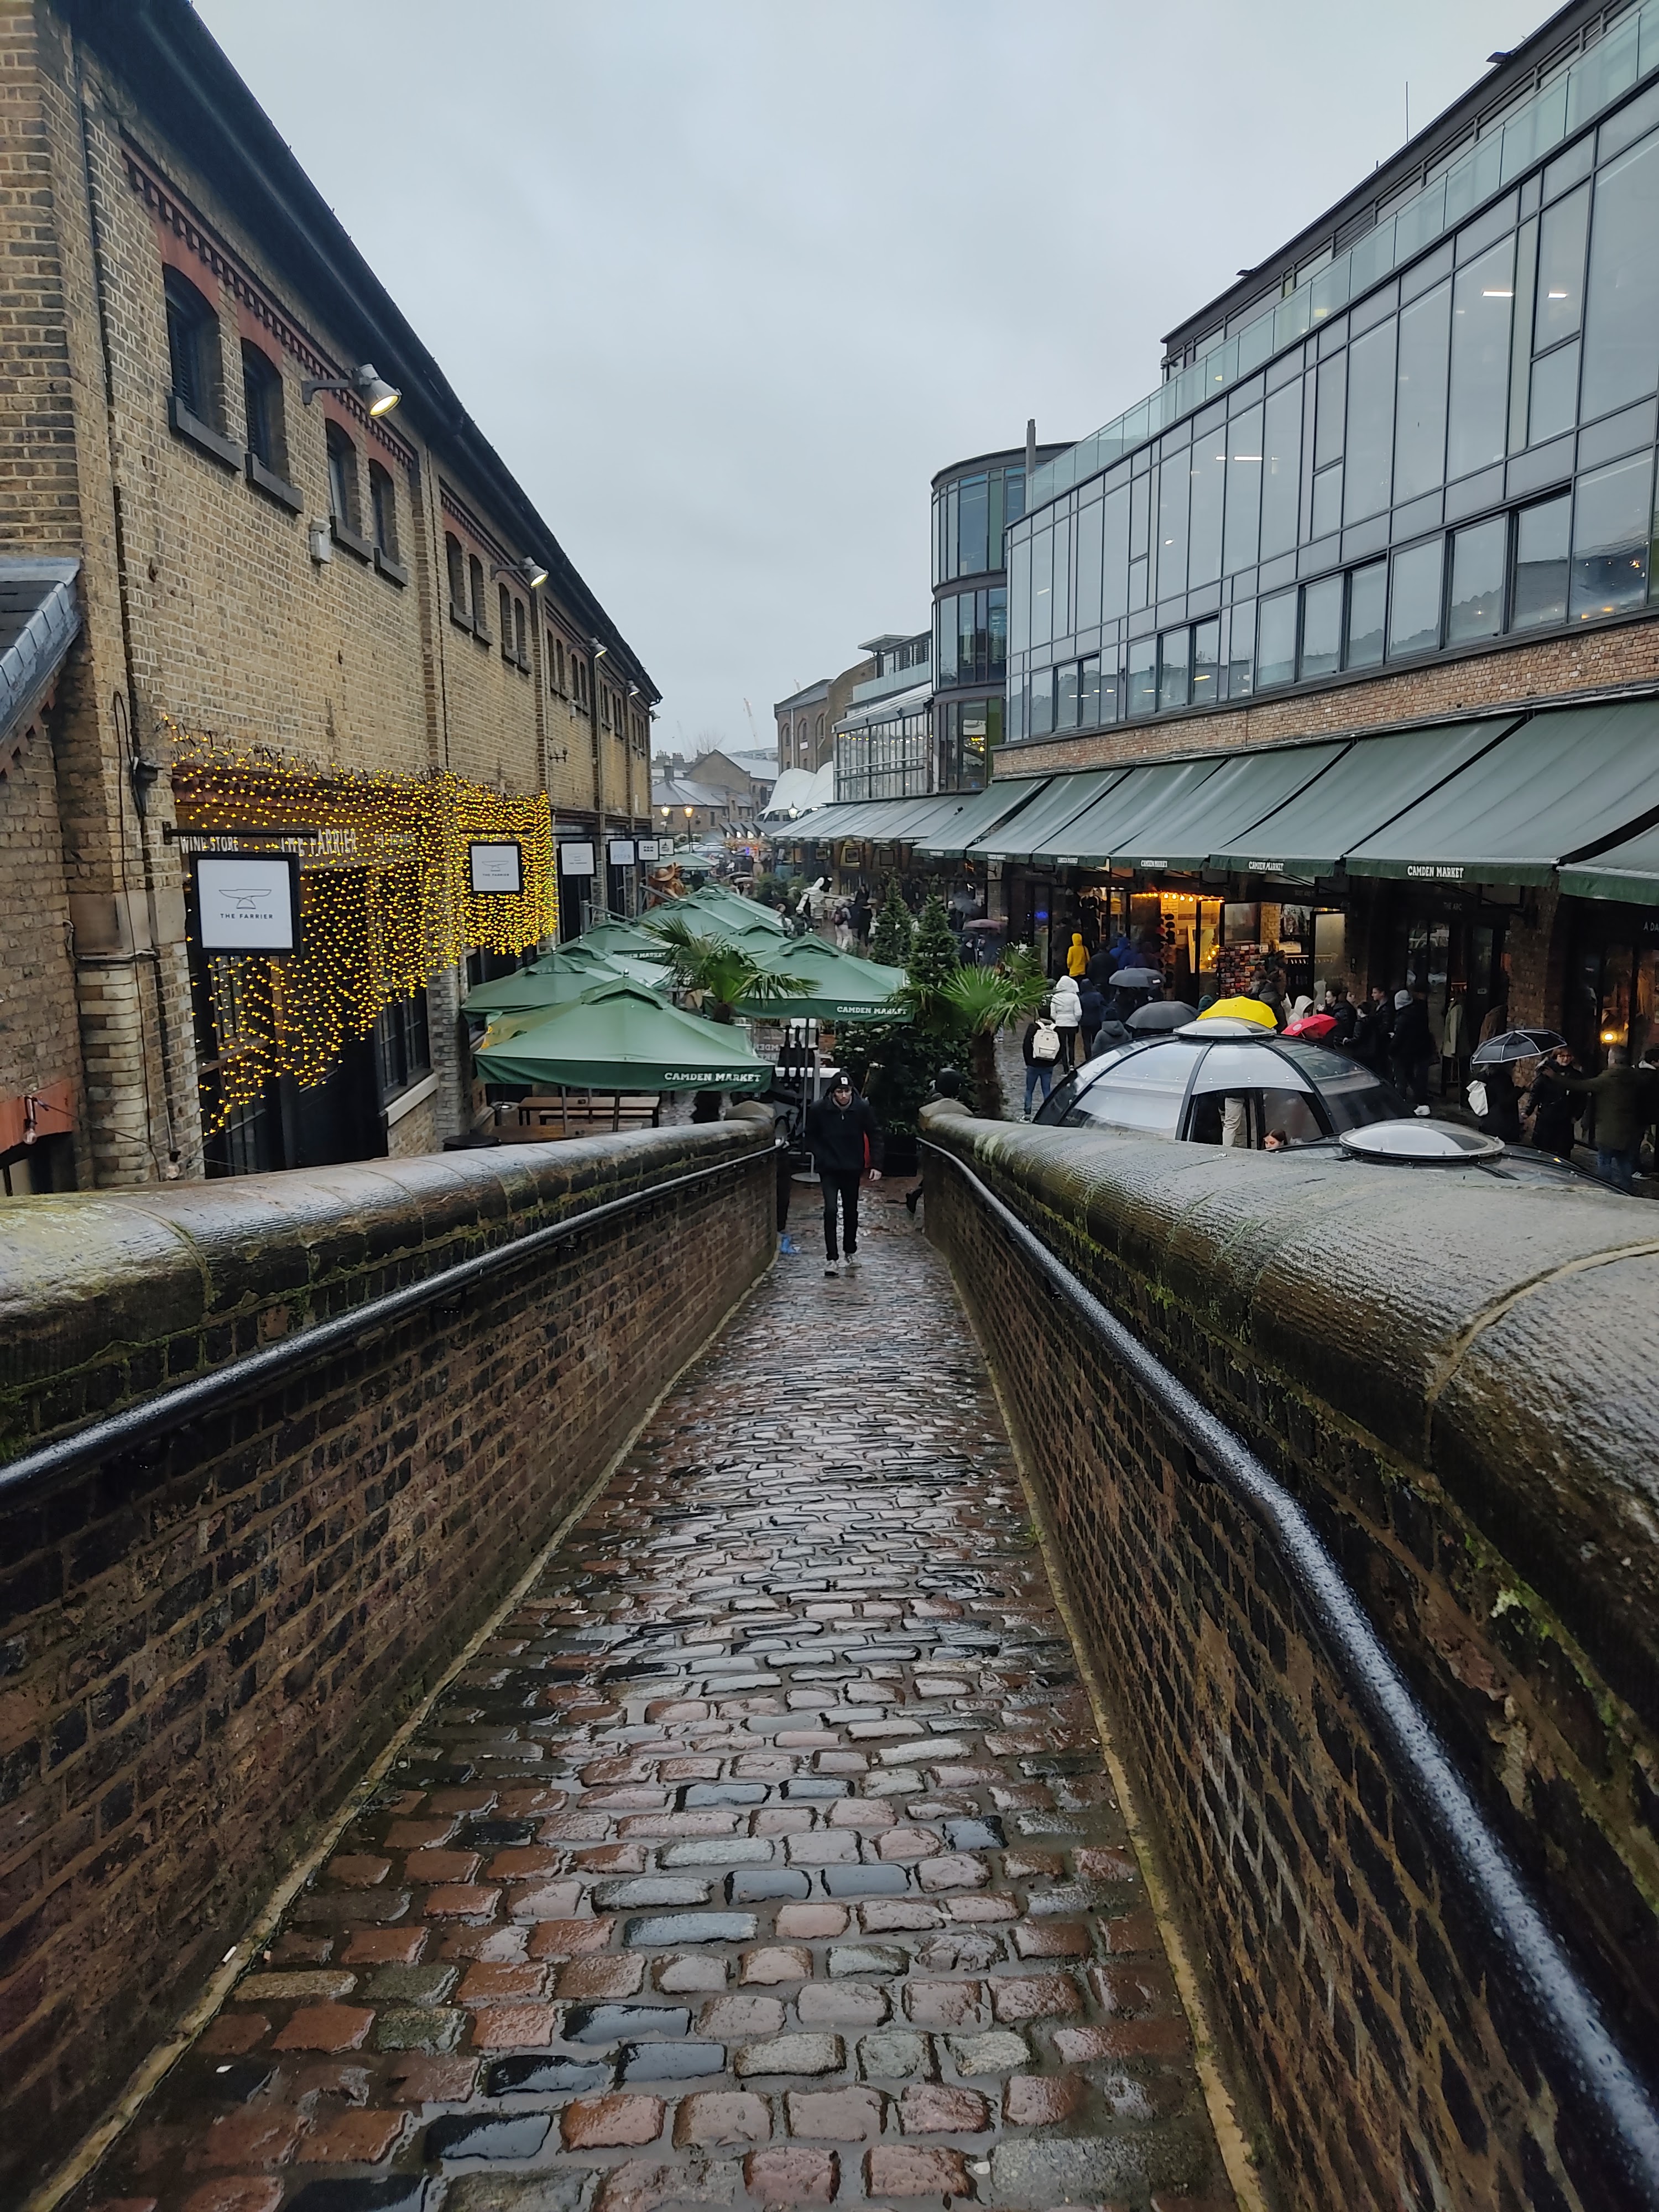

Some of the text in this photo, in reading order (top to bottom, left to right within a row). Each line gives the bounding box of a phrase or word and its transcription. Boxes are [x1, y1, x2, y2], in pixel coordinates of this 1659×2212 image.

[210, 836, 239, 852] STORE
[1407, 865, 1464, 878] CAMDEN MARKET
[664, 1072, 761, 1082] CAMDEN MARKET
